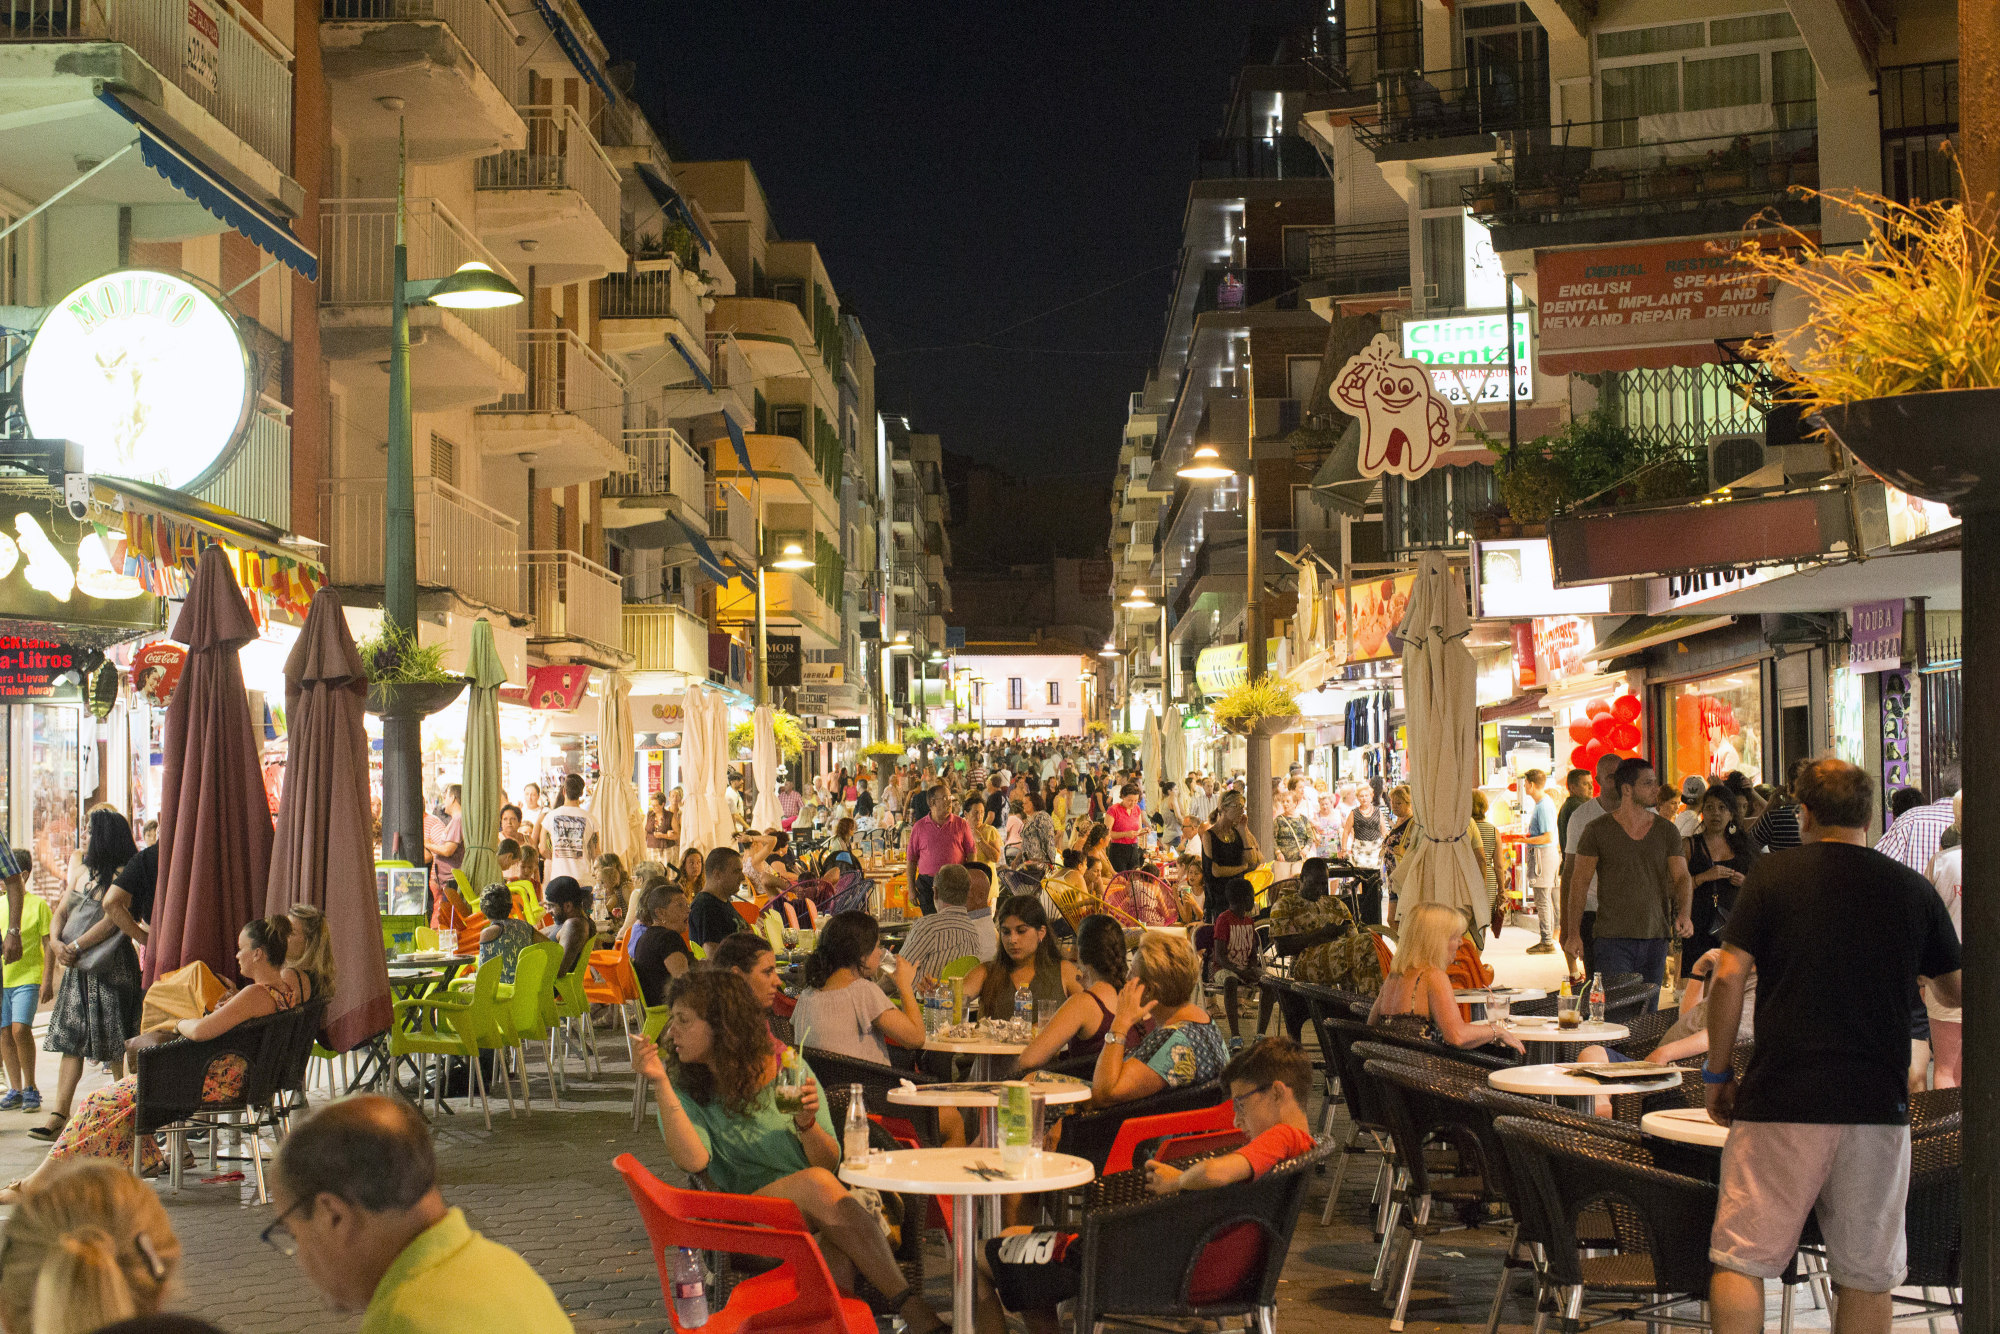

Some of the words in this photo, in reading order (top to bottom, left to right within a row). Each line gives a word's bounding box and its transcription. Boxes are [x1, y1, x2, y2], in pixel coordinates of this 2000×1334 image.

[1585, 263, 1648, 278] DENTAL
[1559, 281, 1631, 298] ENGLISH
[1673, 270, 1761, 289] SPEAKING
[67, 278, 196, 335] MOJITO
[1543, 298, 1608, 314] DENTAL
[1618, 291, 1703, 309] IMPLANTS
[1720, 287, 1757, 301] AND
[1543, 316, 1585, 329] NEW
[1588, 312, 1623, 327] AND
[1630, 308, 1691, 323] REPAIR
[1410, 320, 1524, 344] Clinica
[1412, 341, 1525, 364] Dental
[1858, 608, 1892, 632] TOUBA
[1850, 638, 1900, 663] BELLEZA
[17, 673, 49, 683] Llevar
[0, 685, 24, 696] Take
[27, 684, 55, 697] Away
[806, 694, 827, 704] EXCHANGE
